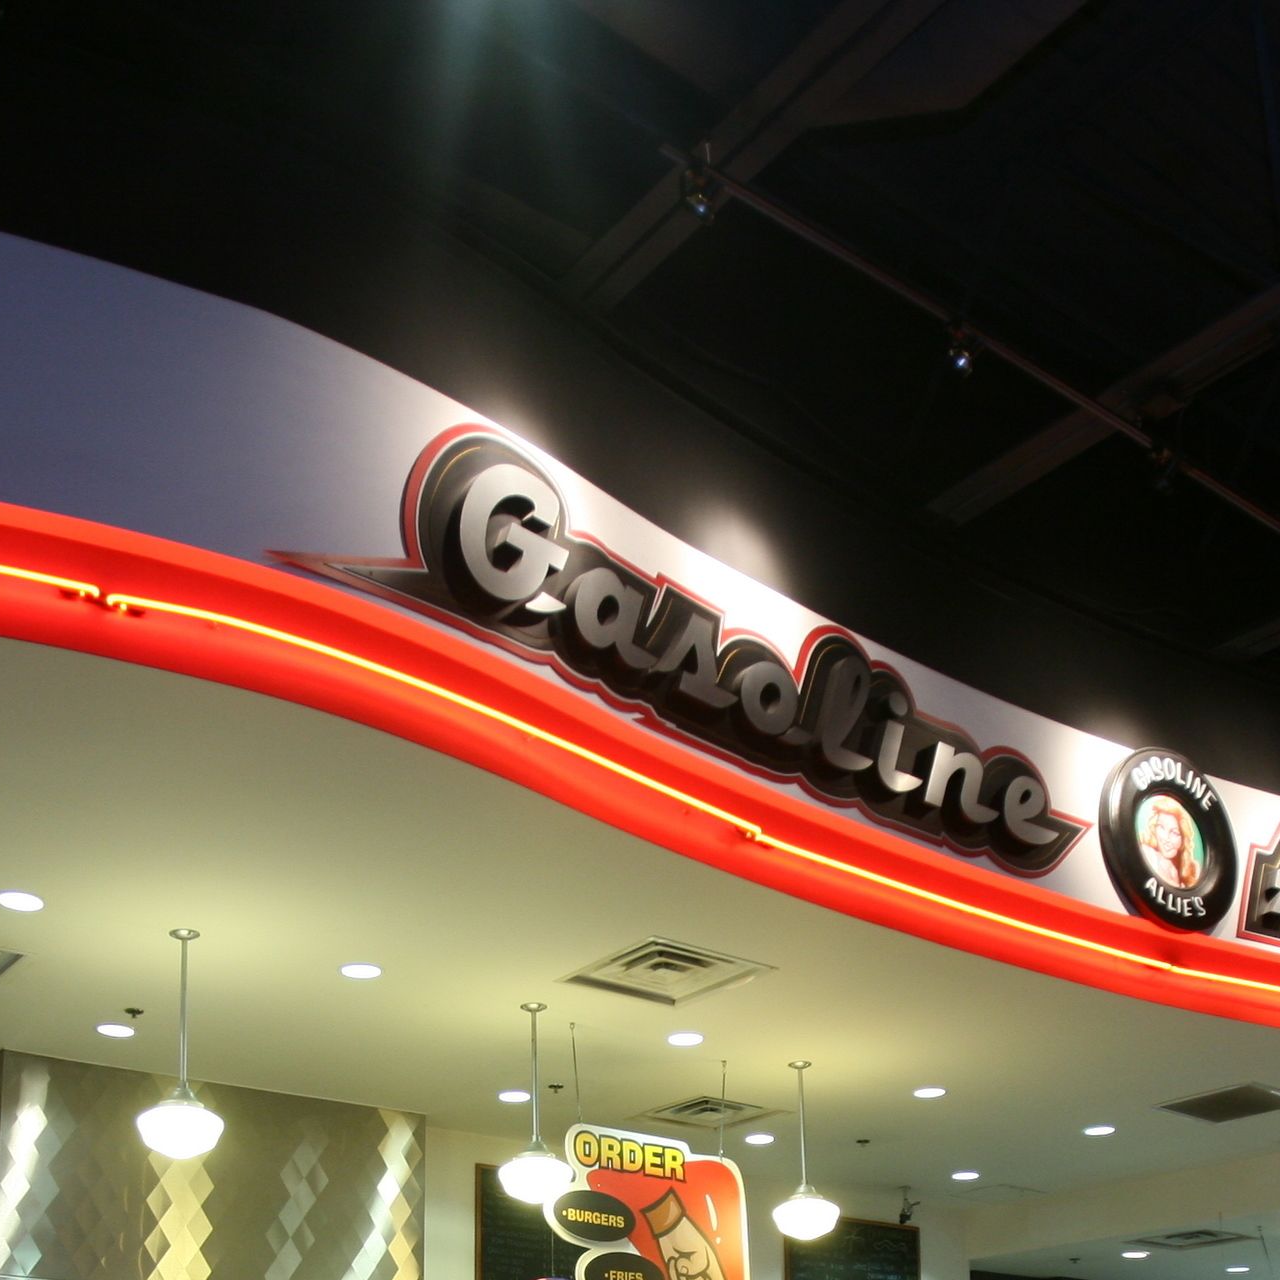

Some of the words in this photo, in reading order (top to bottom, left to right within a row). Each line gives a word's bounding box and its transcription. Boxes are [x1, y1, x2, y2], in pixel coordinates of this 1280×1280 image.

[458, 462, 1061, 847] Gasoline
[1131, 756, 1218, 811] GASOLINE
[1145, 876, 1207, 918] ALLIE'S
[574, 1130, 687, 1183] ORDER
[566, 1208, 625, 1229] BURGERS
